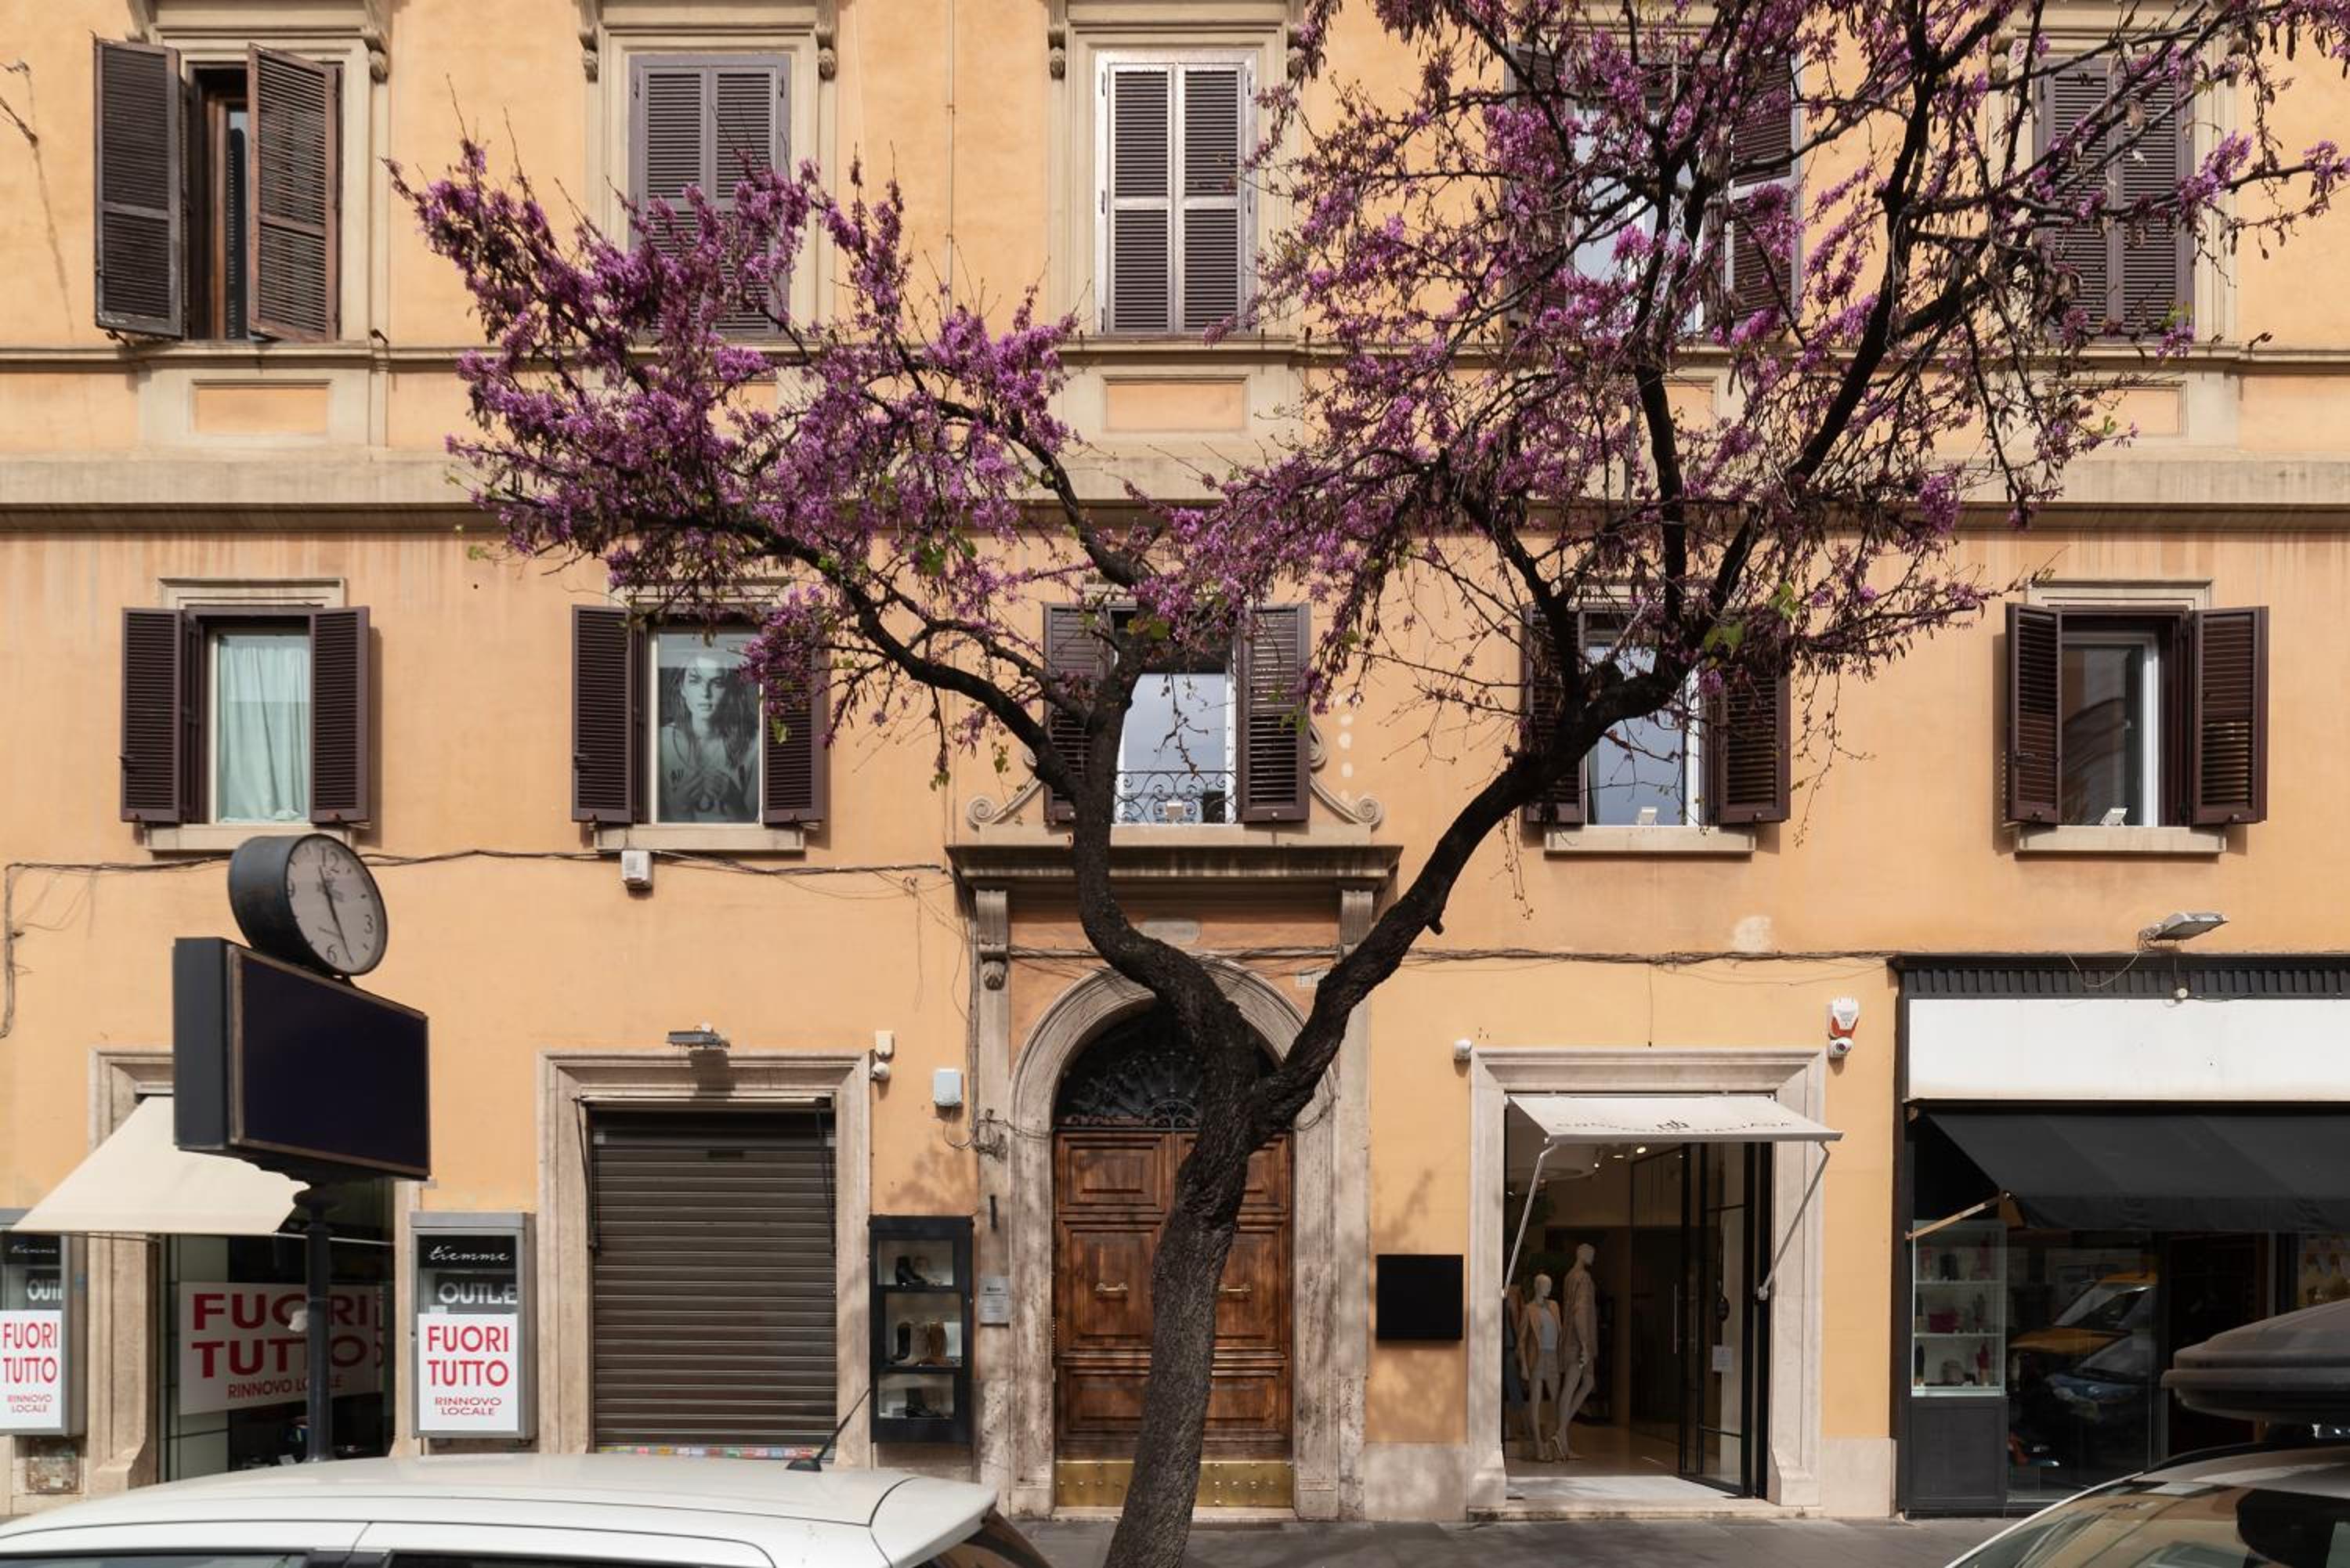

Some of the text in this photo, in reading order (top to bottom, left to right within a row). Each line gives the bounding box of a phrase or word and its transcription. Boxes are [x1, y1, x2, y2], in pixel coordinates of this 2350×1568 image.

[321, 847, 339, 874] 12
[364, 914, 374, 934] 3
[327, 943, 338, 963] 6
[4, 1322, 57, 1349] FUORI
[428, 1326, 509, 1352] FUORI
[3, 1357, 57, 1383] TUTTO
[427, 1360, 508, 1386] TUTTO
[228, 1379, 292, 1399] RINNOVO
[435, 1397, 501, 1406] RINNOVO
